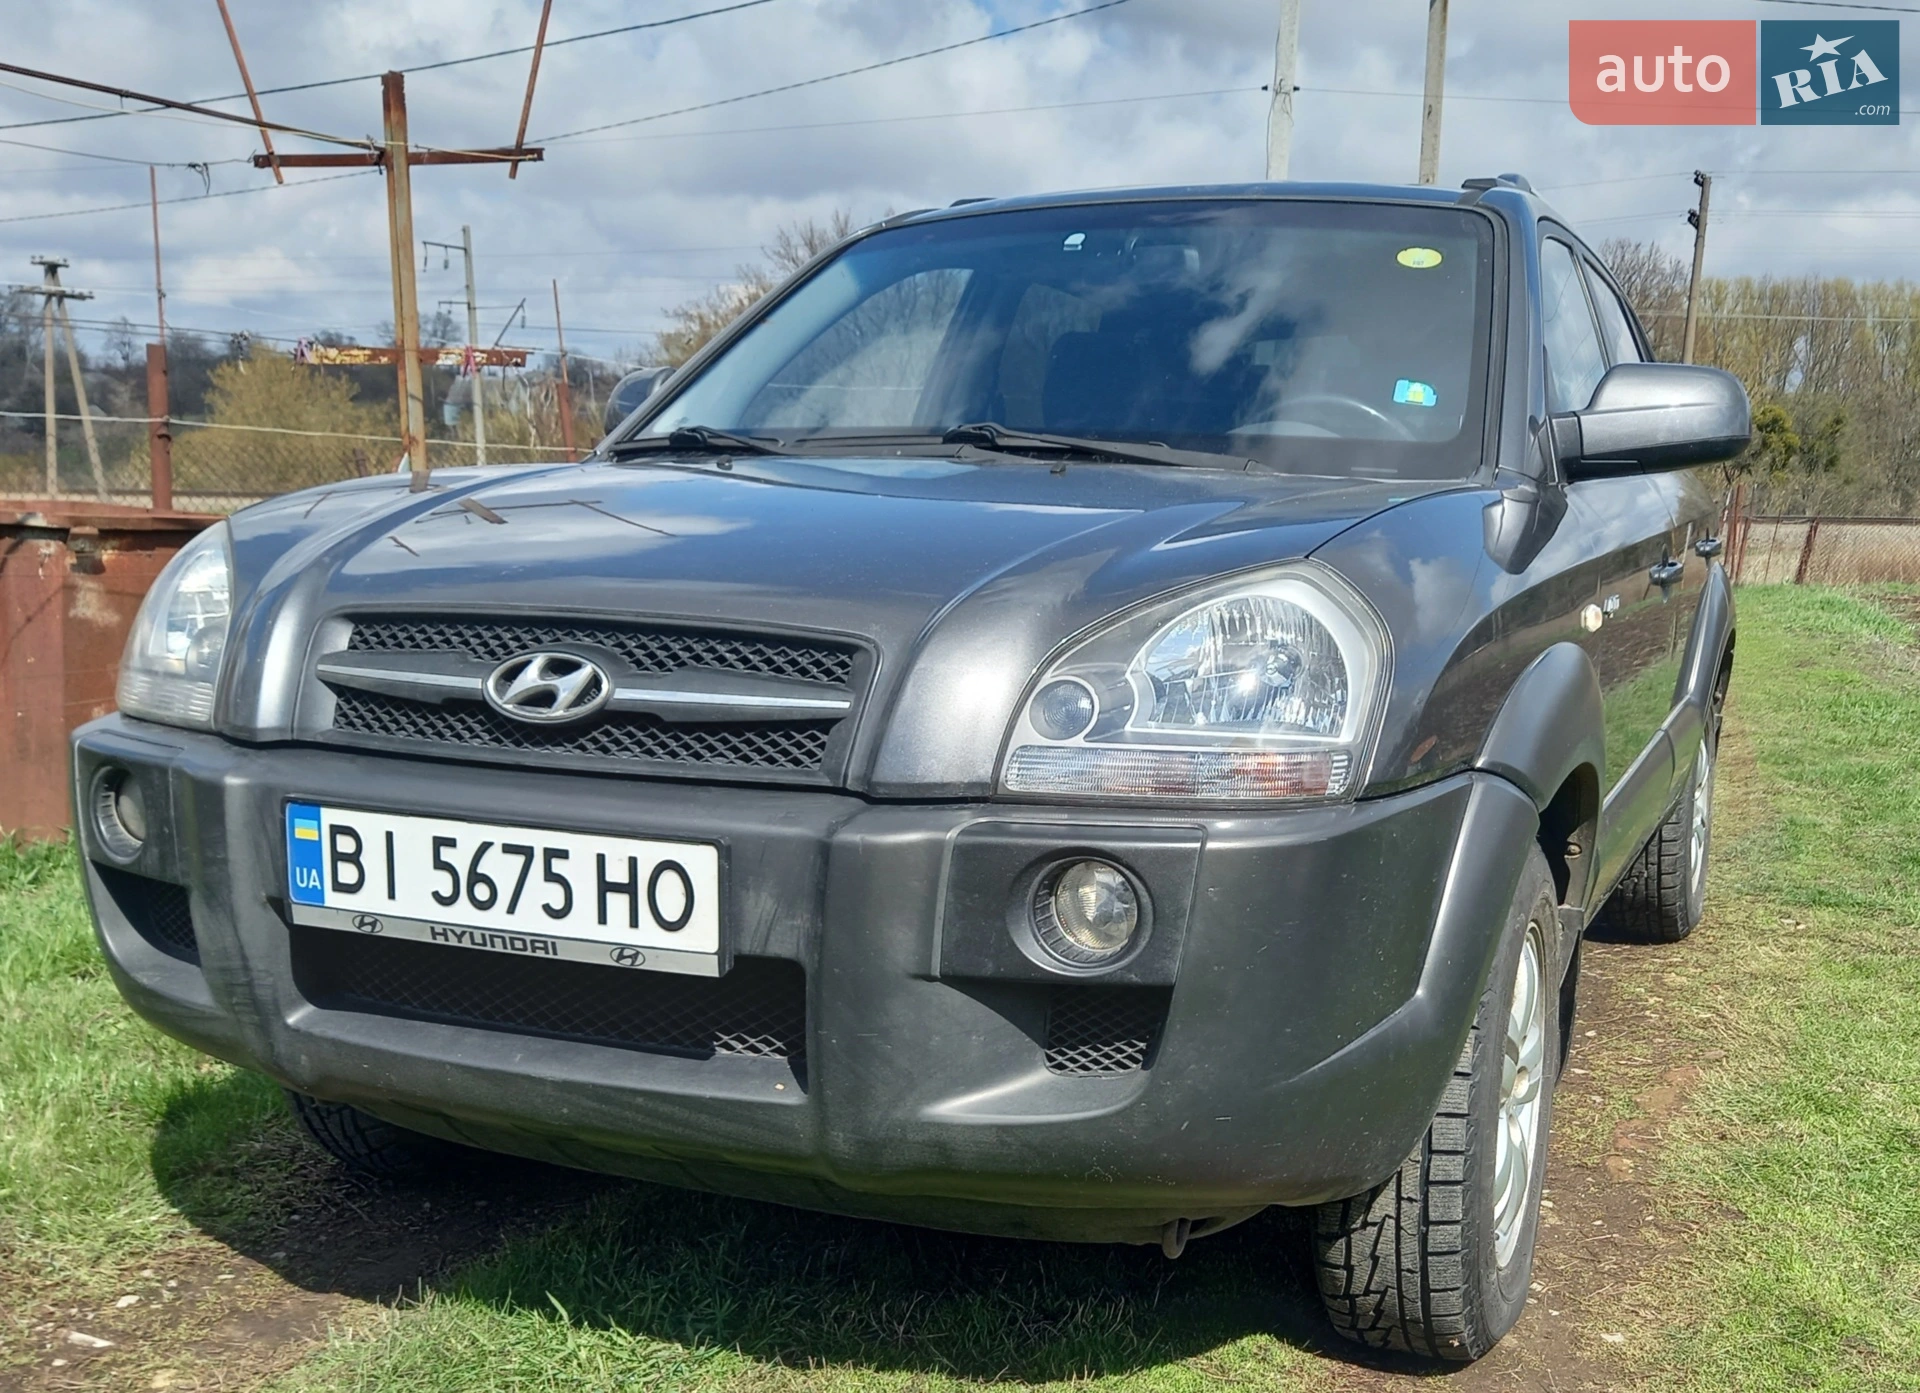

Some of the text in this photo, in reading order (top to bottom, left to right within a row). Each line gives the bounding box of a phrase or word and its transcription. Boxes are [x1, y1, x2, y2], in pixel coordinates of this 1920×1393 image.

[296, 867, 321, 890] UA
[329, 824, 695, 932] BI 5675 HO
[430, 926, 558, 956] HYUNDAI
